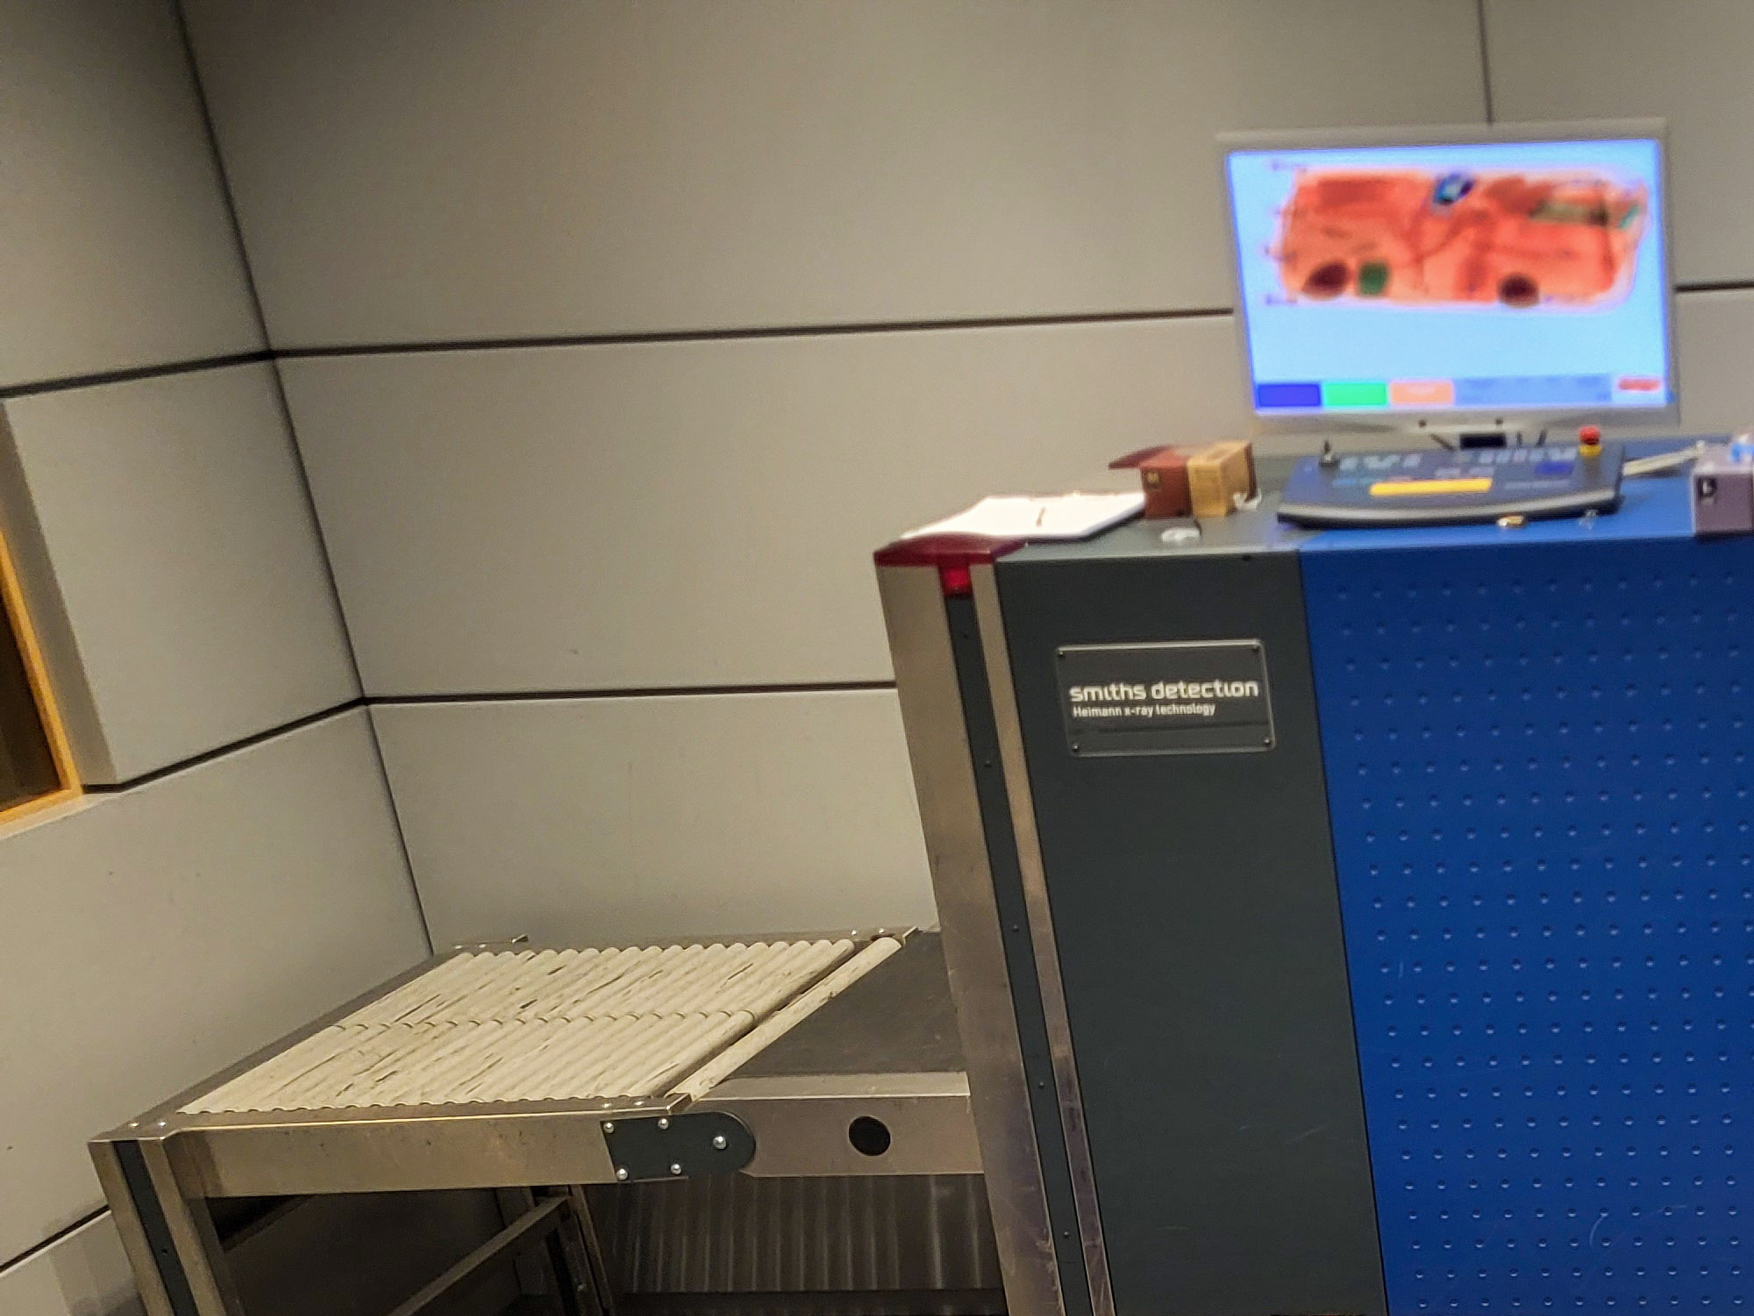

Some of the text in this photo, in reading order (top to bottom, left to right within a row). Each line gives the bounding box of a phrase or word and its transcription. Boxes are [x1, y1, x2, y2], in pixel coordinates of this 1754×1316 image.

[1069, 679, 1259, 702] smiths detection
[1073, 703, 1216, 718] Heimann x-ray technology
